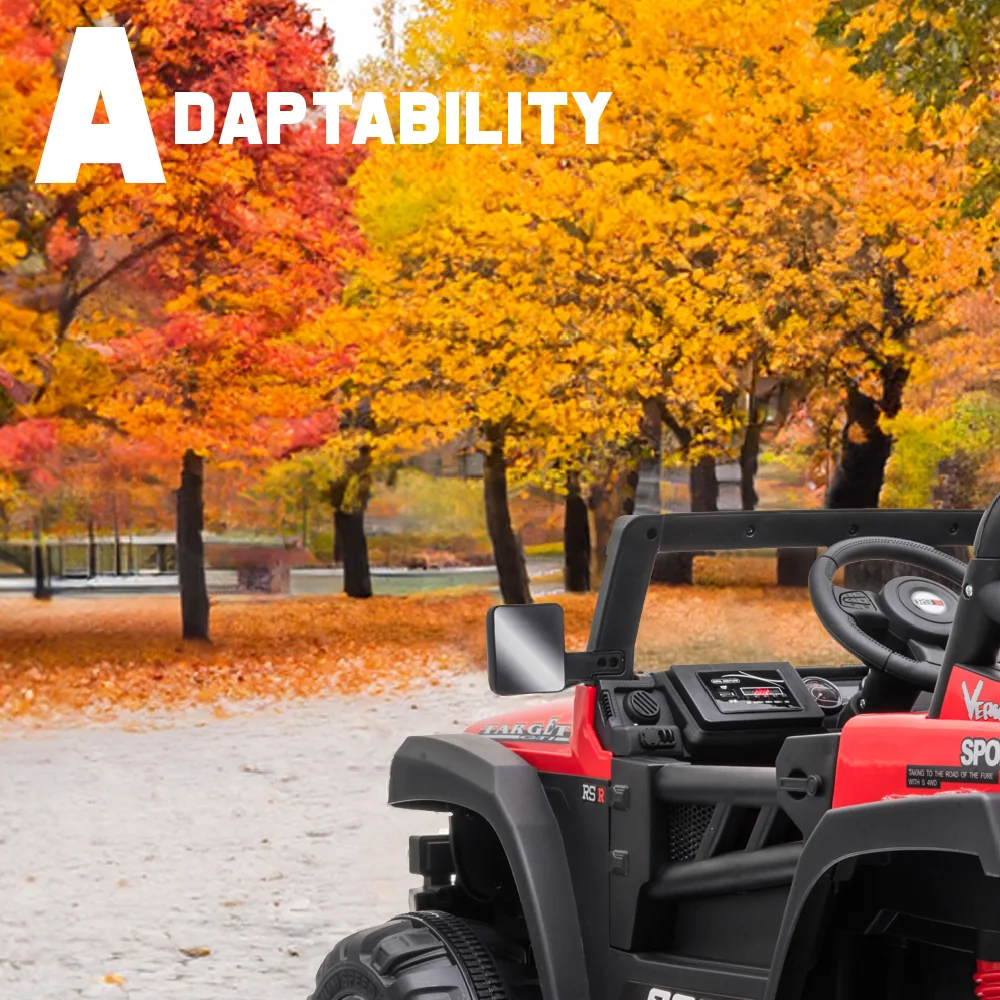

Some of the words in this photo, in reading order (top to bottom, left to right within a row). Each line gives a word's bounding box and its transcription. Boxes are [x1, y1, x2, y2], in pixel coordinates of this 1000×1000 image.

[908, 768, 925, 777] TAKING
[926, 769, 934, 777] TO
[935, 770, 944, 778] THE
[961, 771, 968, 779] OF
[969, 771, 979, 779] THE
[927, 779, 938, 787] 4WD
